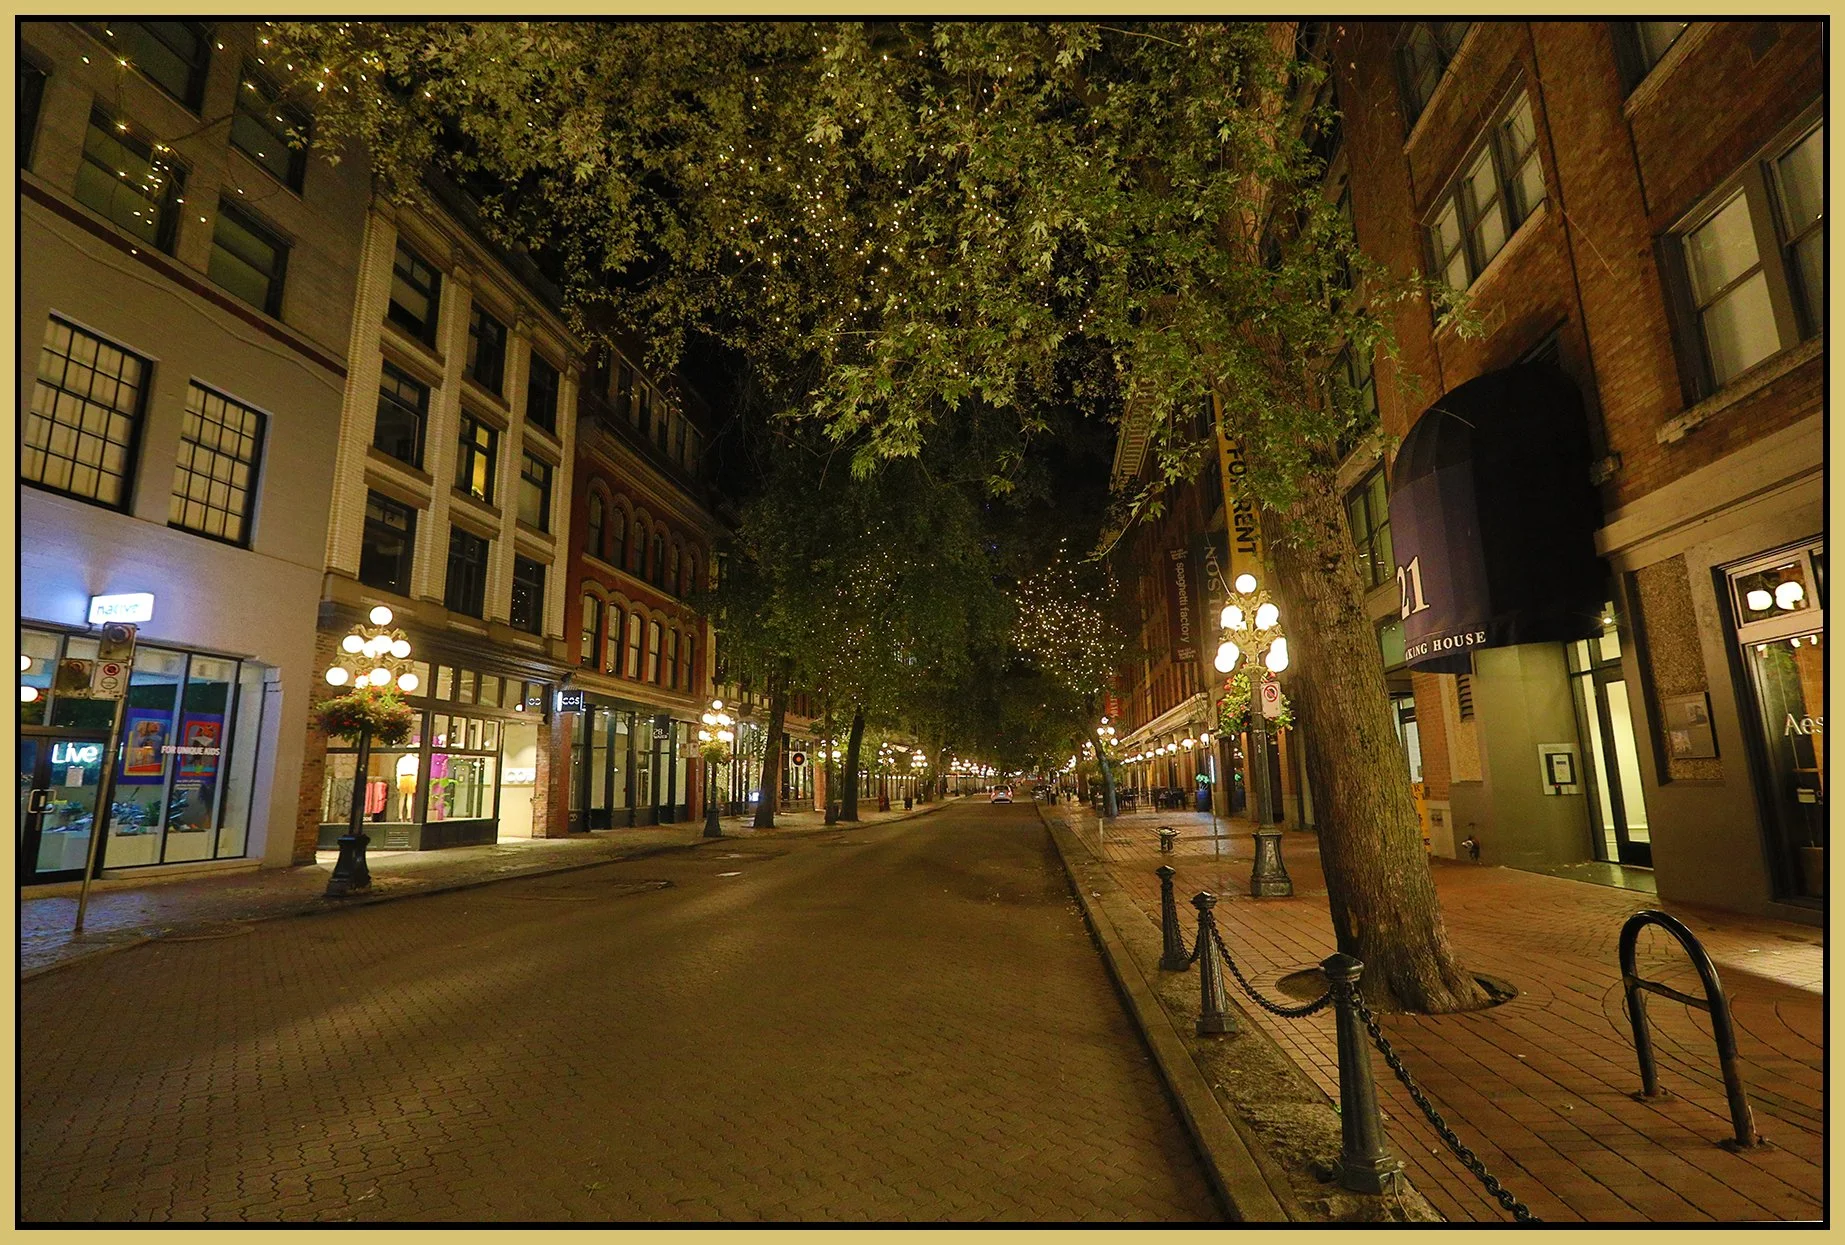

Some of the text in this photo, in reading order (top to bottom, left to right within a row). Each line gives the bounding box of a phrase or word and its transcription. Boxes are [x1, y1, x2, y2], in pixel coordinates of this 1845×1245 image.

[1232, 499, 1257, 554] RENT
[1176, 562, 1189, 606] spaghetti
[1396, 556, 1430, 621] 21
[1180, 605, 1191, 643] factory
[1433, 631, 1487, 652] HOUSE
[562, 696, 580, 706] COS
[51, 742, 98, 764] Live
[161, 745, 220, 756] FOR UNIQUE KIDS
